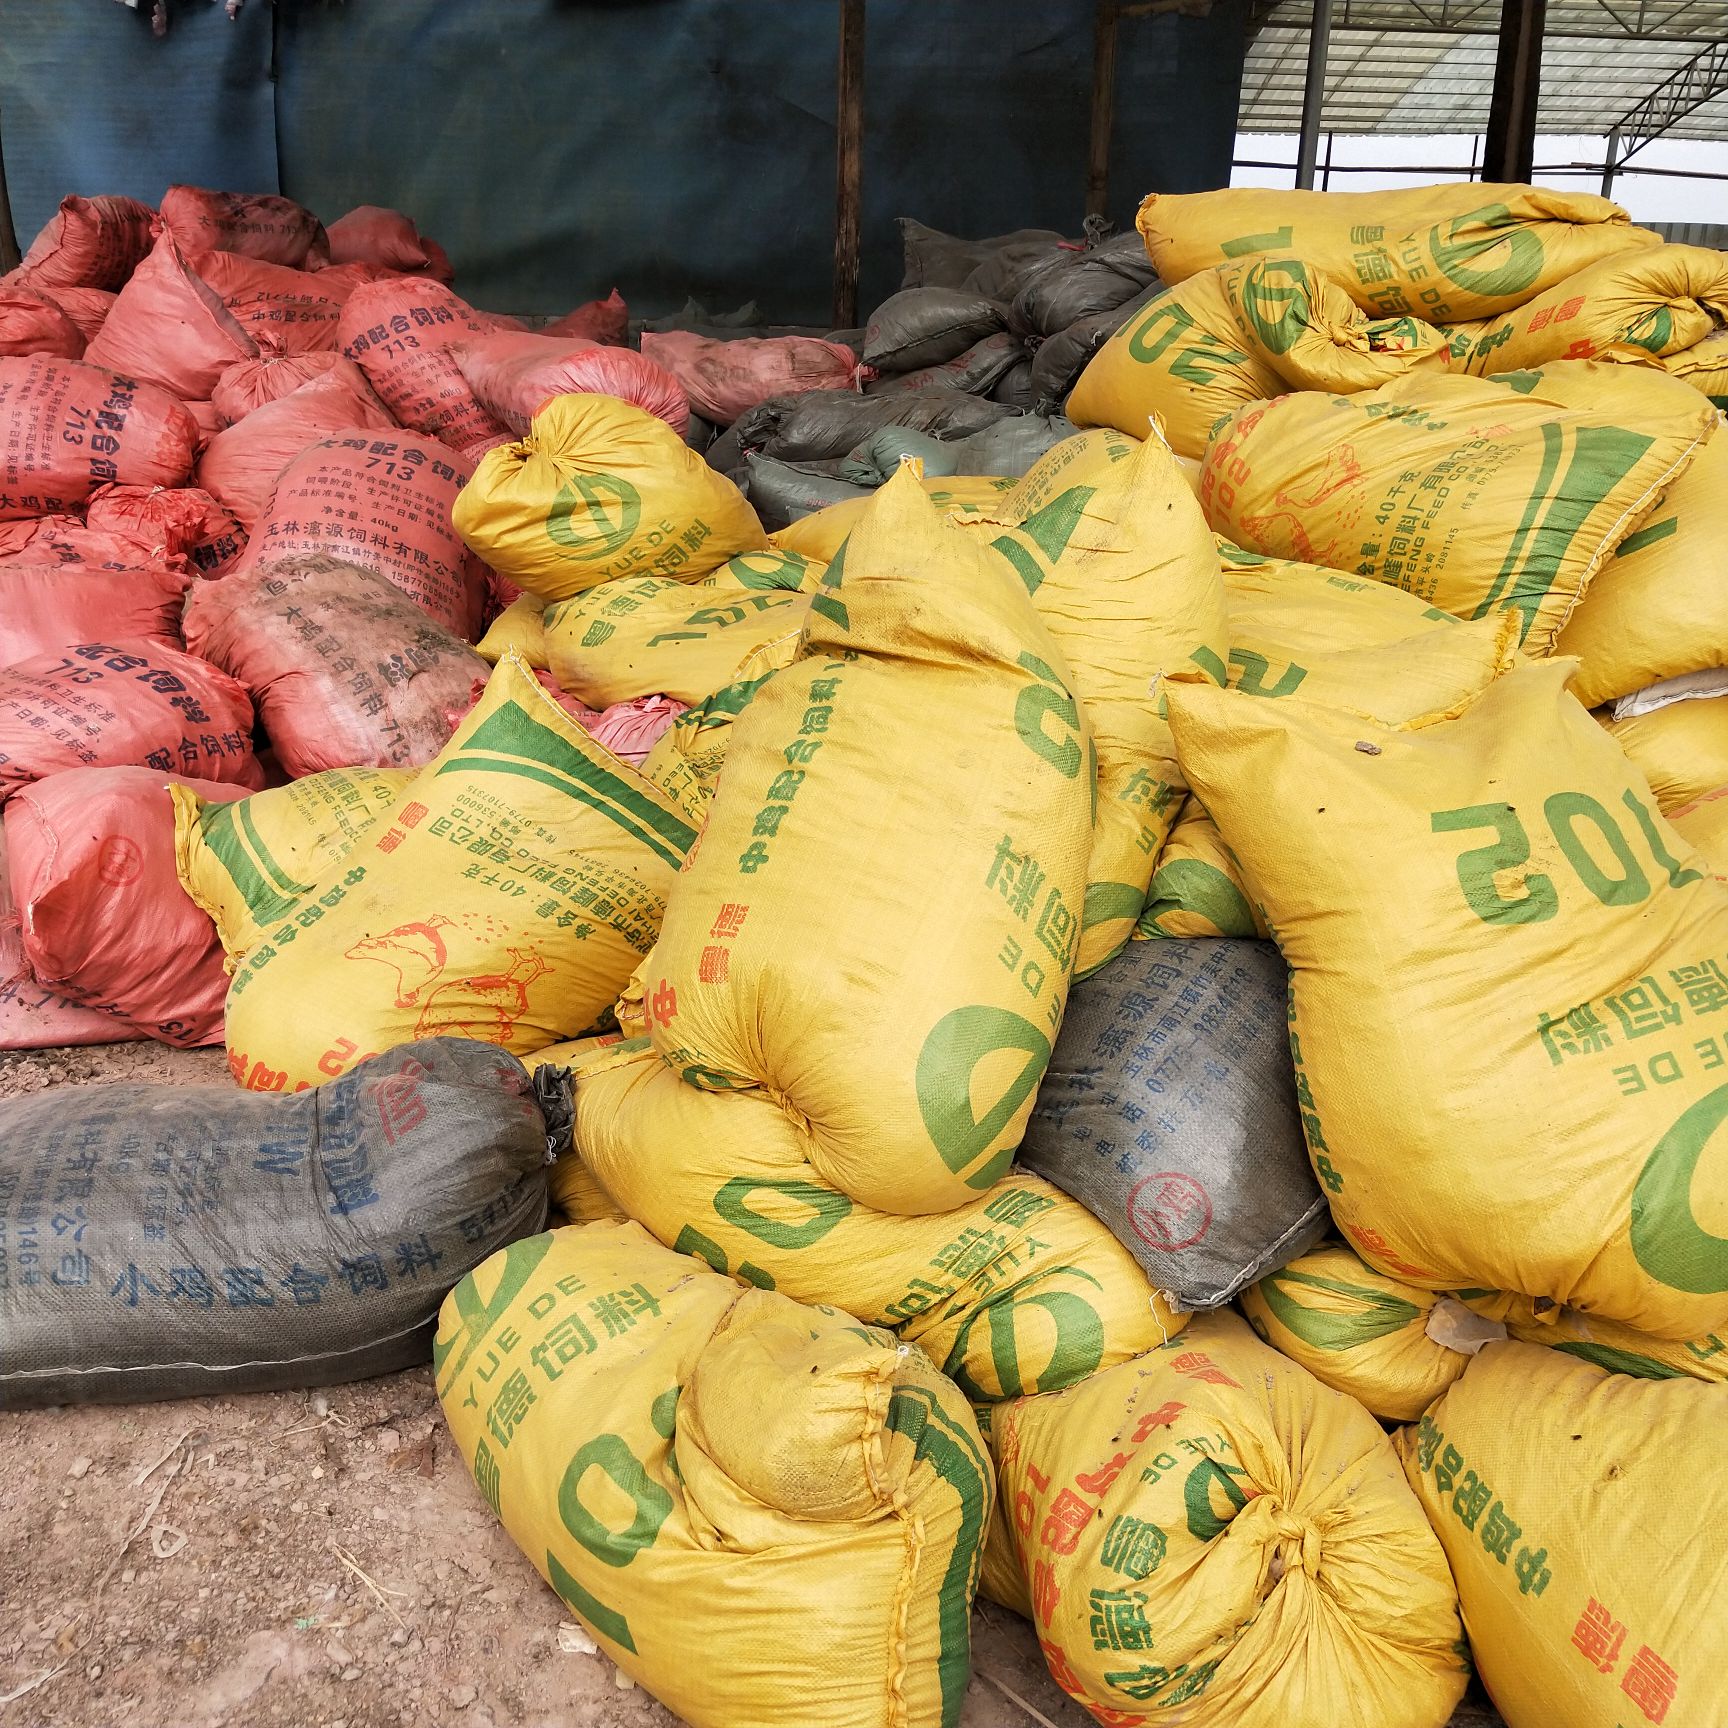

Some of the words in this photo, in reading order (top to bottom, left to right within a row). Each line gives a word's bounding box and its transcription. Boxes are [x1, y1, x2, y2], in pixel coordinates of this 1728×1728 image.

[1419, 287, 1452, 318] DE
[343, 305, 455, 361] 大鸡配合饲料
[381, 335, 421, 360] 713
[63, 405, 92, 446] 713
[365, 457, 416, 482] 713
[370, 516, 400, 533] 40kg
[1420, 486, 1451, 531] FEED
[599, 546, 648, 579] YUE
[645, 519, 677, 548] DE
[45, 658, 105, 684] 713
[738, 675, 843, 875] 中鸡配合饲料
[1430, 787, 1705, 926] 105
[562, 865, 631, 909] DEFENG
[231, 865, 367, 997] 中鸡配合饲料
[1612, 1049, 1685, 1097] DE
[462, 1325, 521, 1410] YUE
[527, 1273, 586, 1322] DE
